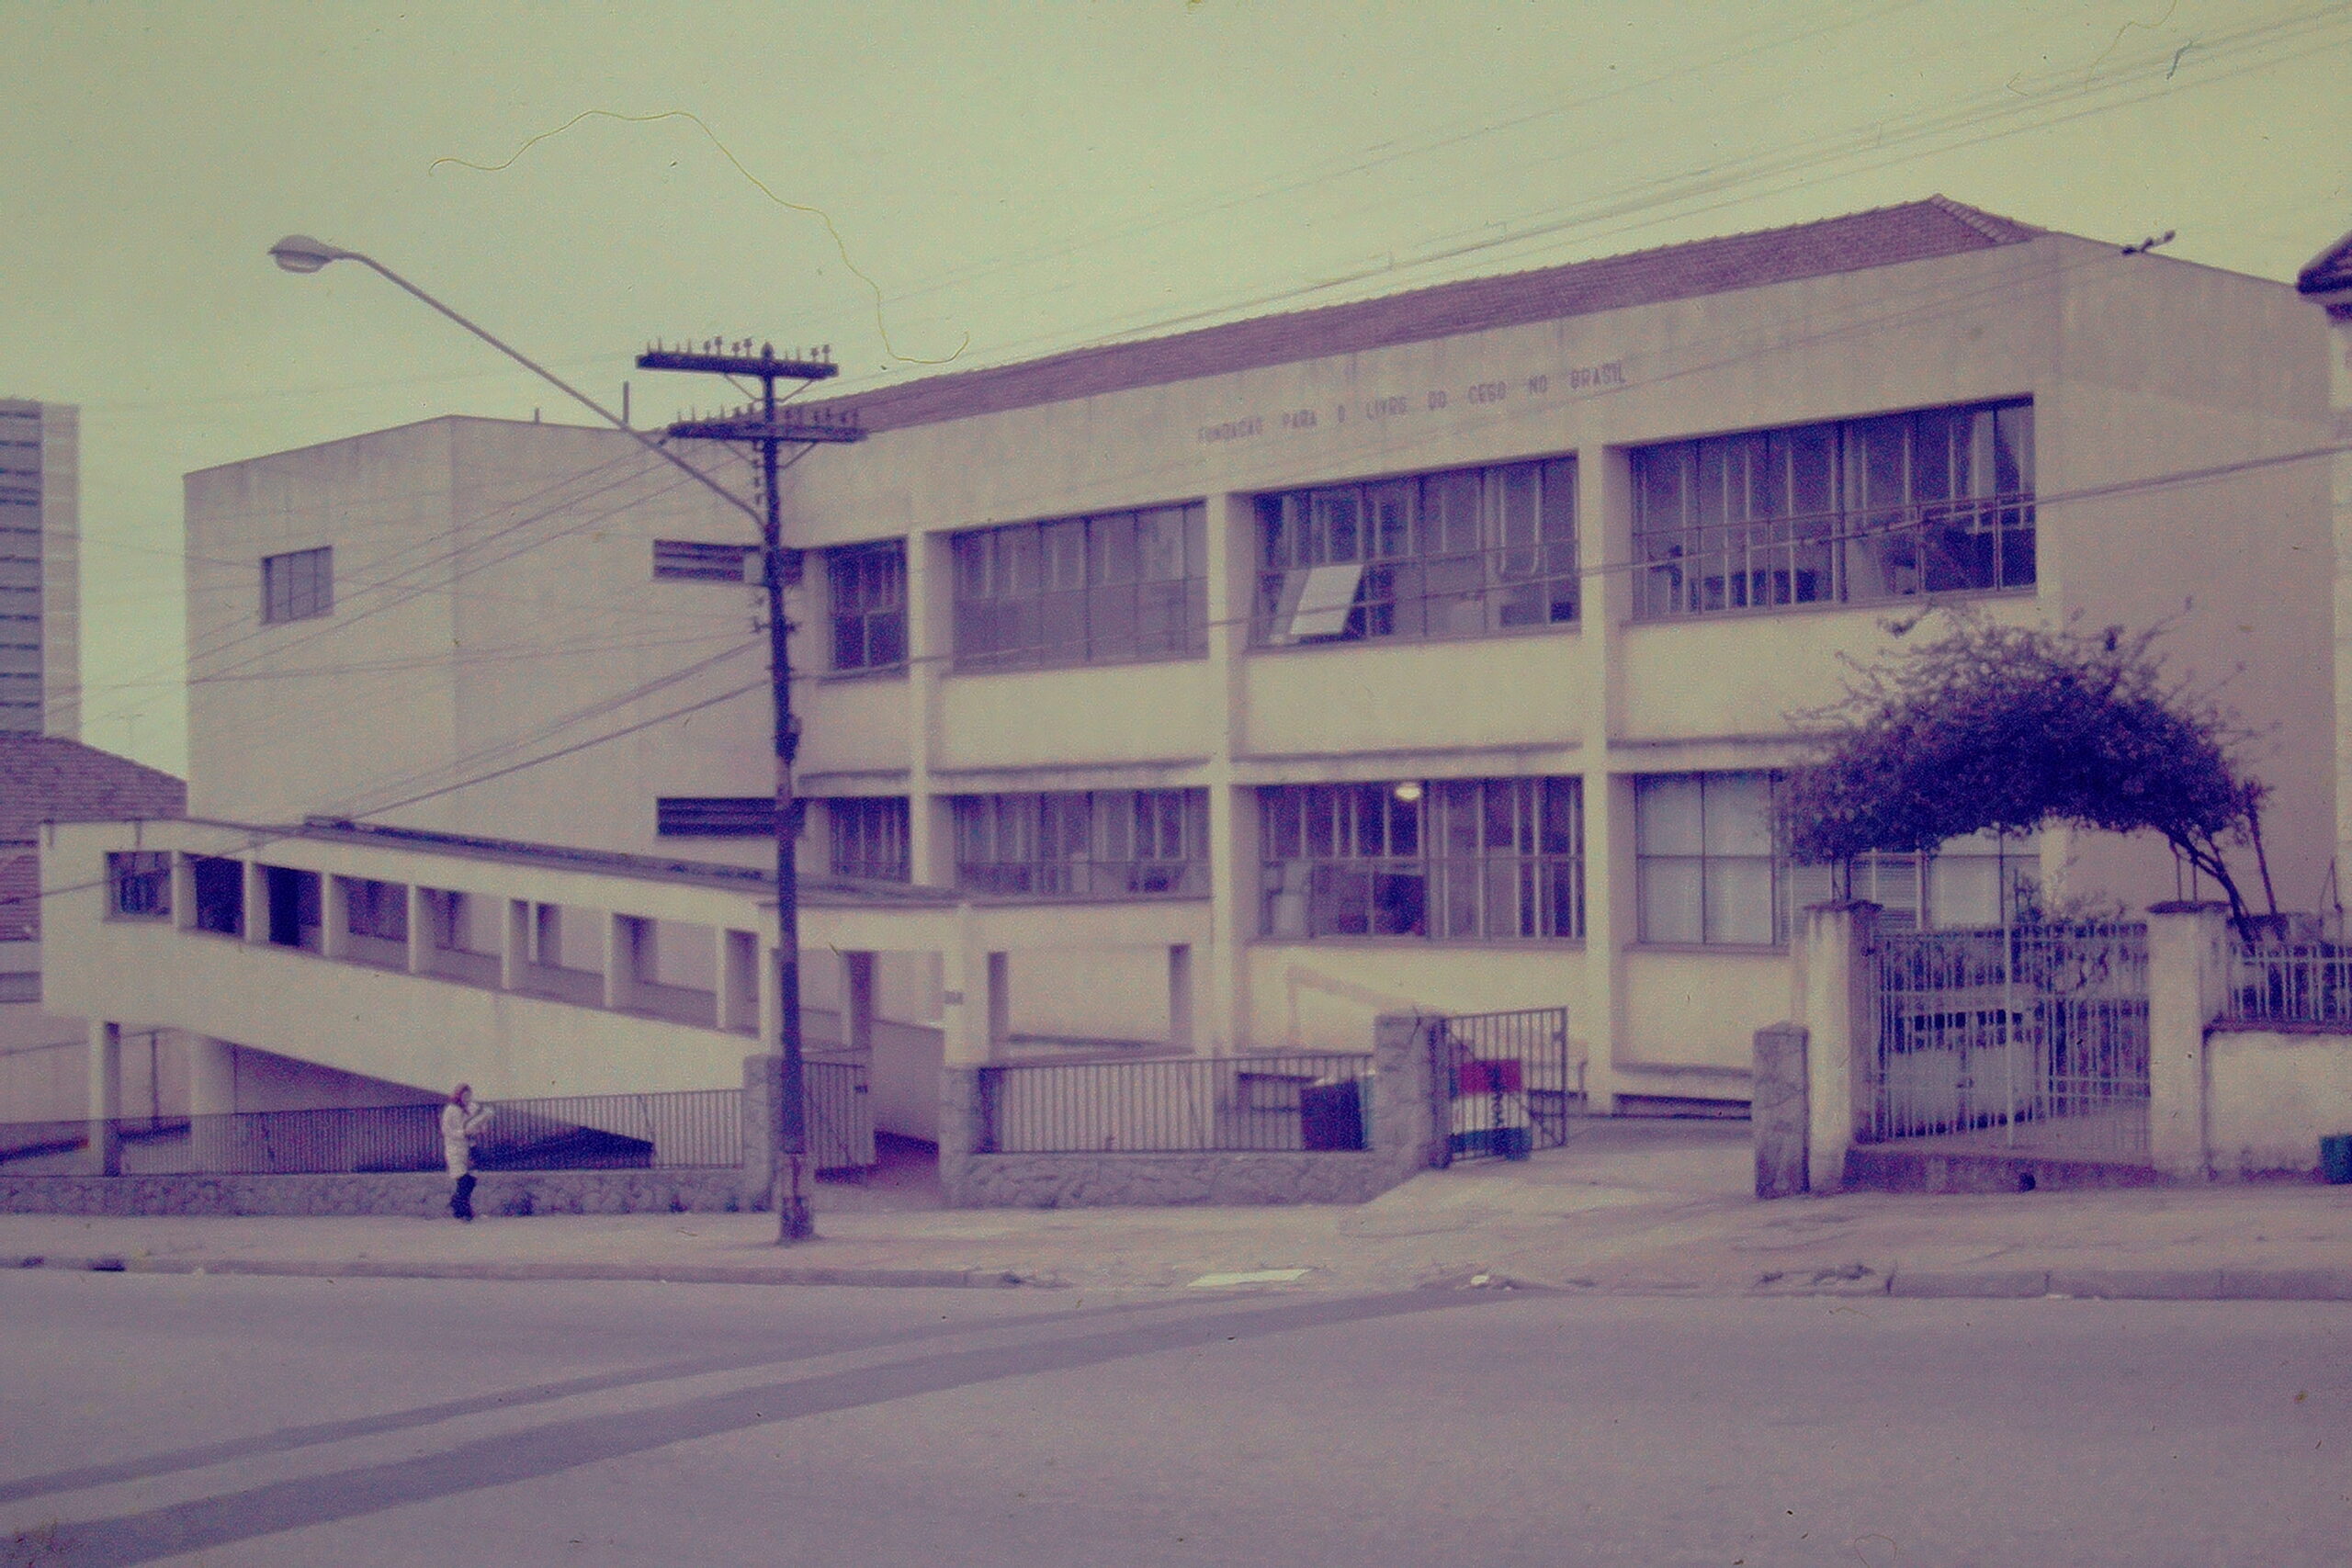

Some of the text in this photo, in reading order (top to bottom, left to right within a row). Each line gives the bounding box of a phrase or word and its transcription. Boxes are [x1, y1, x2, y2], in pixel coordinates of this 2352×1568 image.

[1283, 410, 1317, 429] PARA
[1428, 390, 1446, 410] DO
[1468, 380, 1507, 404] CEGO
[1529, 375, 1547, 394] NO
[1570, 361, 1625, 389] BRASIL
